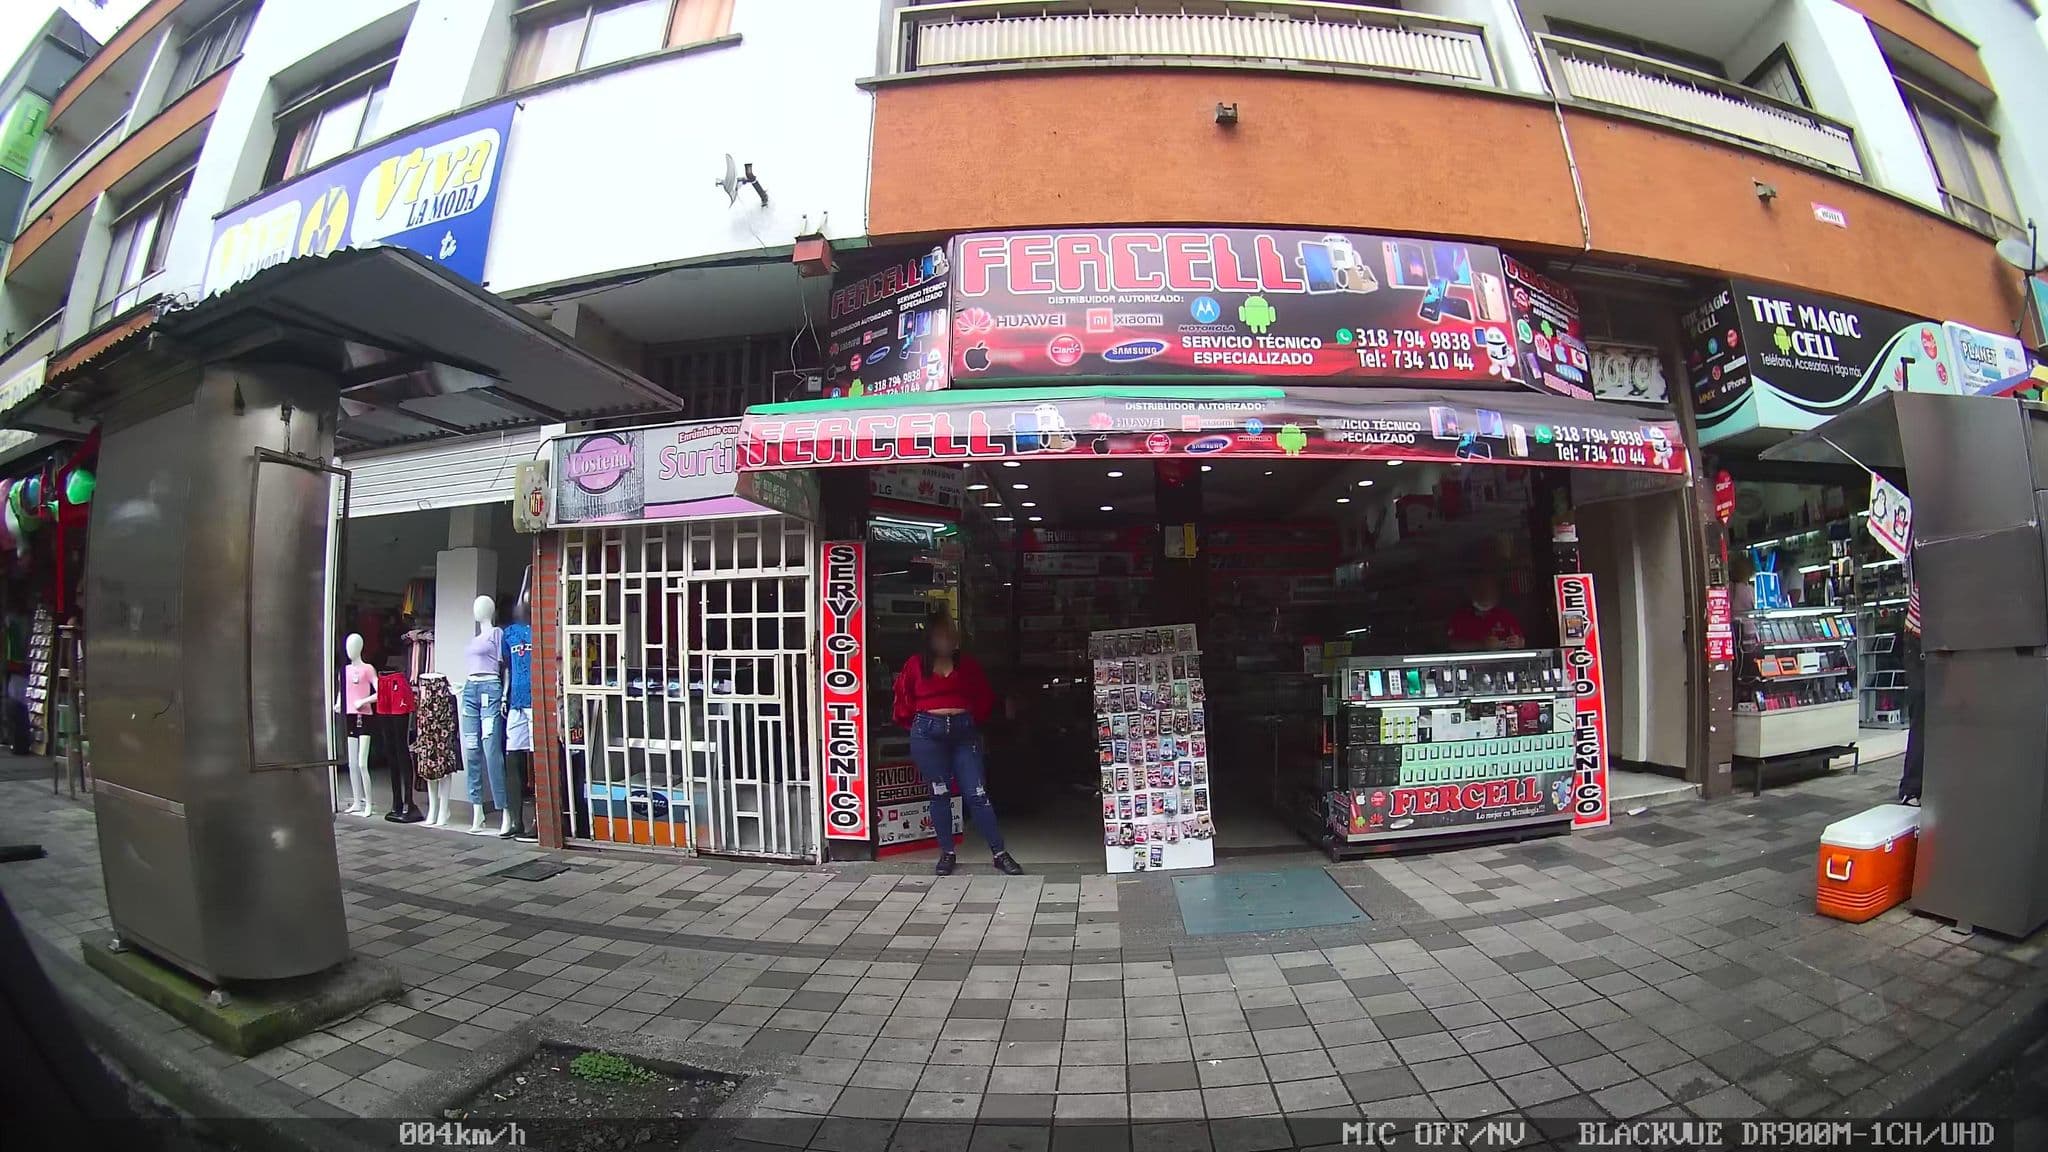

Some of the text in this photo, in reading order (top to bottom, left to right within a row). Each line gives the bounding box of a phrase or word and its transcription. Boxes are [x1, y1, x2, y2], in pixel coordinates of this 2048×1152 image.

[406, 184, 479, 228] LA MODA
[896, 290, 922, 305] SERVICIO
[900, 290, 944, 311] ESPECIALIZADO
[1048, 294, 1185, 305] DISTRIBUIDOR AUTORIZADO:
[1699, 290, 1731, 318] MAGIC
[996, 314, 1064, 328] HUAWEI
[1114, 314, 1162, 325] xiaomi
[1697, 313, 1719, 335] CELL
[1746, 295, 1862, 339] THE MAGIC
[1178, 324, 1236, 333] MOTOROLA
[1182, 333, 1322, 350] SERVICIO TÉCNICO
[1356, 328, 1471, 350] 318 794 9838
[1791, 330, 1840, 361] CELL
[1112, 347, 1157, 355] SAMSUNG
[1193, 351, 1314, 365] ESPECIALIZADO
[1357, 348, 1475, 371] Tel: 734 10 44
[1834, 363, 1849, 378] algo
[873, 369, 921, 393] 318 794 9838
[1125, 402, 1266, 411] DISTRIBUIDOR AUTORIZADO:
[722, 425, 739, 435] con
[1372, 418, 1421, 432] TÉCNICO
[1553, 425, 1644, 447] 318 794 9838
[1555, 442, 1646, 465] Tel: 734 10 44
[879, 483, 893, 495] LG
[825, 545, 861, 831] SERVICIO TECNICO
[1388, 775, 1544, 818] FERCELL
[1476, 812, 1485, 820] Lo
[1485, 811, 1502, 820] mejor
